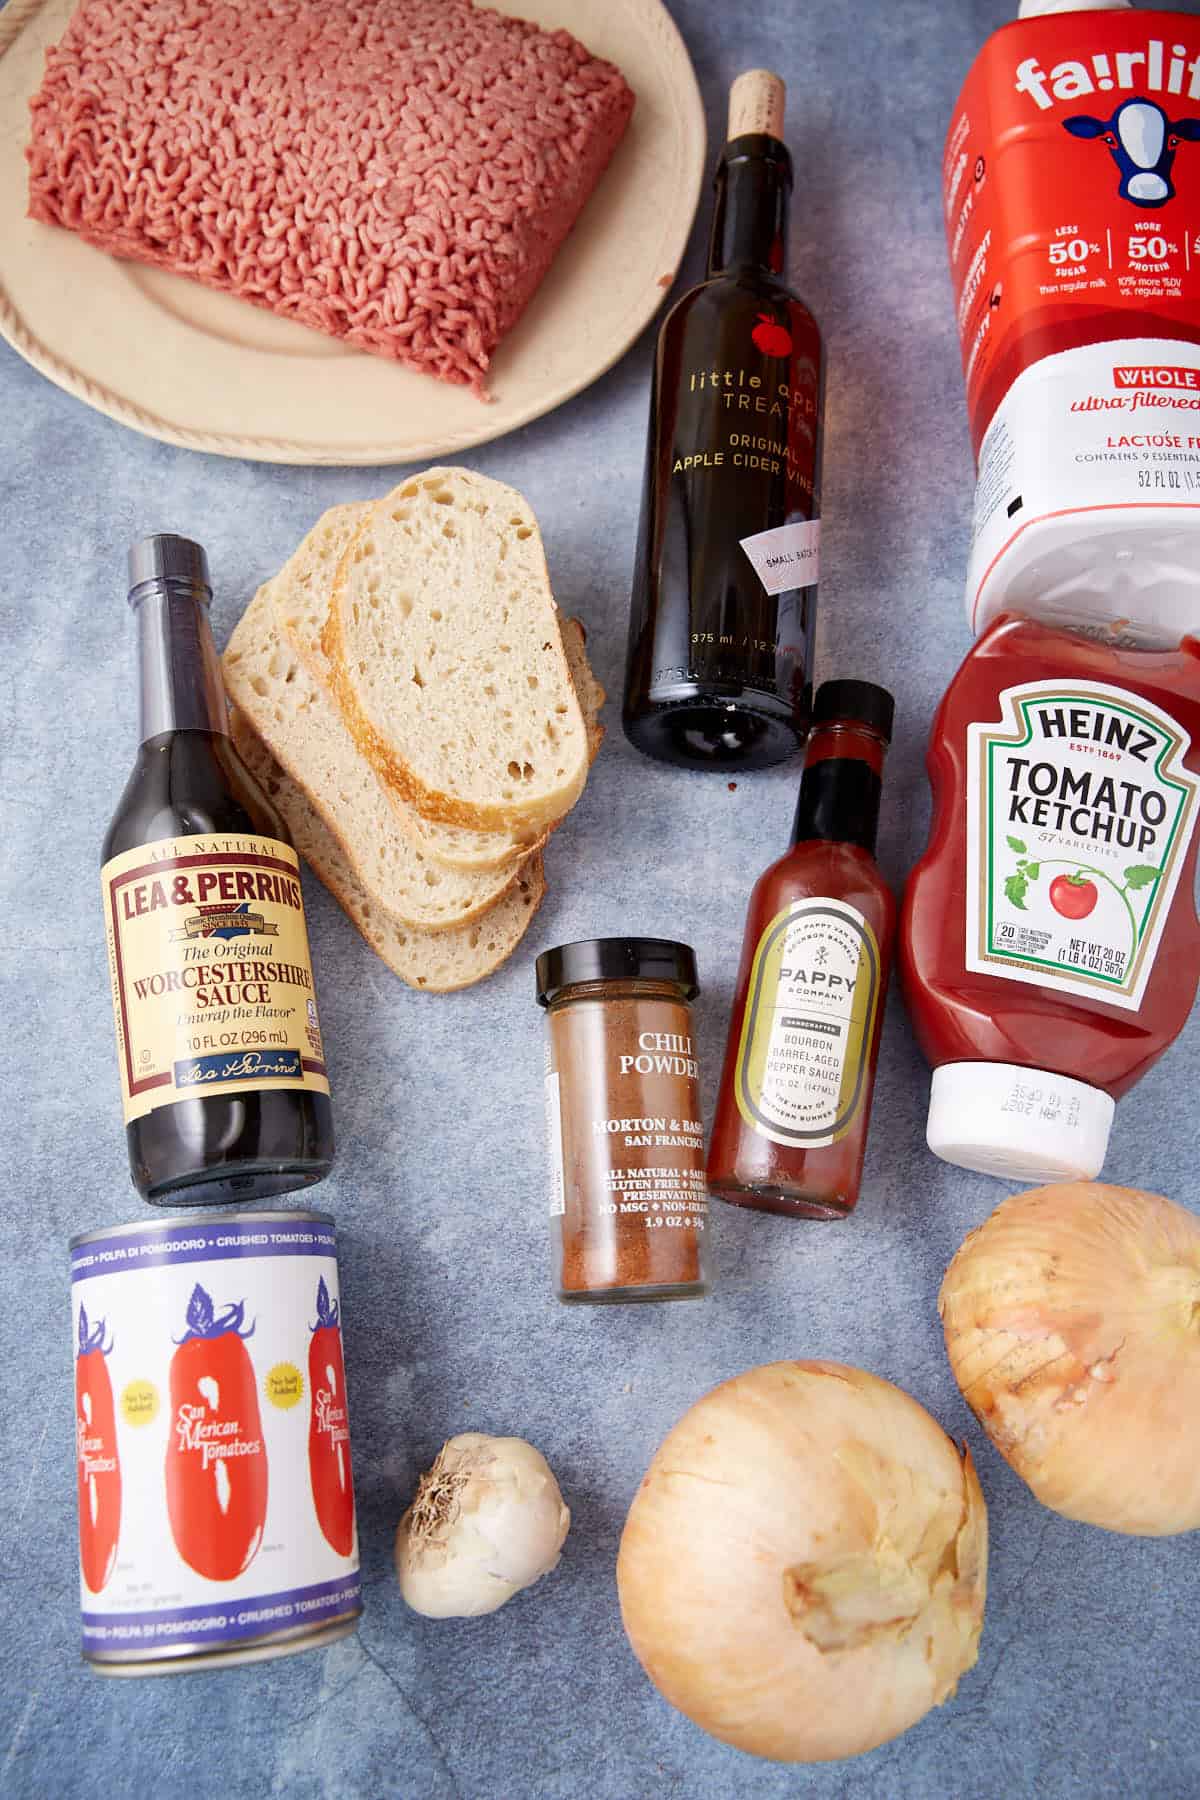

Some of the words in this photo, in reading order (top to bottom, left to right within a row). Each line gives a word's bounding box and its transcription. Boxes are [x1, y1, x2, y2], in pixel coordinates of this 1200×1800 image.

[1055, 225, 1078, 237] LESS
[1134, 221, 1162, 232] MORE
[1048, 239, 1100, 264] 50%
[1127, 236, 1178, 259] 50%
[1055, 264, 1087, 277] SUGAR
[1128, 260, 1170, 273] PROTEIN
[1060, 280, 1088, 293] regular
[1089, 278, 1106, 288] milk
[1138, 278, 1161, 286] more
[1135, 287, 1164, 297] regular
[1166, 287, 1182, 296] milk
[1117, 369, 1198, 387] WHOLE
[690, 369, 762, 392] little
[778, 384, 817, 417] app
[729, 433, 799, 465] ORIGINAL
[1106, 435, 1184, 448] LACTOSE
[1074, 453, 1138, 463] CONTAINS
[1142, 453, 1149, 461] 9
[672, 453, 725, 473] APPLE
[733, 454, 781, 475] CIDER
[786, 467, 816, 495] VINE
[1138, 470, 1151, 488] 52
[1155, 471, 1166, 488] FL
[1168, 471, 1181, 488] OZ
[766, 555, 795, 568] SMALL
[691, 633, 714, 643] 375
[1037, 708, 1159, 762] HEINZ
[1097, 747, 1121, 761] 1869
[1006, 757, 1167, 826] TOMATO
[1008, 794, 1157, 853] KETCHUP
[151, 844, 179, 861] ALL
[195, 840, 277, 857] NATURAL
[1038, 831, 1056, 843] 57
[1057, 837, 1120, 858] VARIETIES
[1001, 925, 1015, 938] 20
[183, 946, 210, 961] The
[213, 943, 273, 960] Original
[1070, 938, 1086, 951] NET
[1088, 943, 1102, 955] WT
[1103, 947, 1114, 959] 20
[1115, 951, 1126, 964] OZ
[1057, 947, 1067, 962] (1
[1068, 950, 1080, 963] LB
[1081, 953, 1087, 965] 4
[1088, 954, 1103, 972] OZ)
[1104, 961, 1124, 978] 567g
[133, 961, 312, 1001] WORCESTERSHIRE
[778, 968, 857, 993] PAPPY
[195, 983, 272, 1008] SAUCE
[796, 987, 844, 1002] COMPANY
[232, 1006, 253, 1019] the
[187, 1034, 201, 1050] 10
[203, 1034, 218, 1049] FL
[219, 1032, 240, 1046] OZ
[241, 1031, 268, 1045] (296
[269, 1031, 288, 1044] mL)
[784, 1034, 833, 1051] BOURBON
[772, 1048, 840, 1068] BARREL-AGED
[767, 1061, 806, 1075] PEPPER
[808, 1067, 841, 1083] SAUCE
[788, 1080, 799, 1088] OZ
[804, 1081, 837, 1097] (147ML)
[592, 1118, 666, 1134] MORTON
[669, 1119, 680, 1131] &
[624, 1135, 652, 1146] SAN
[602, 1169, 625, 1180] ALL
[627, 1168, 680, 1179] NATURAL
[654, 1179, 680, 1189] FREE
[619, 1202, 649, 1213] MSG
[644, 1216, 663, 1228] 1.9
[665, 1216, 683, 1227] OZ
[99, 1250, 127, 1263] POLPA
[128, 1247, 140, 1259] DI
[140, 1238, 206, 1256] POMODORO
[216, 1234, 269, 1247] CRUSHED
[271, 1233, 314, 1244] TOMATOES
[178, 1404, 206, 1430] San
[176, 1420, 239, 1452] Merican
[200, 1438, 261, 1470] Tomatoes
[156, 1616, 226, 1635] POMODORO
[238, 1605, 292, 1625] CRUSHED
[295, 1593, 340, 1615] TOMATOES
